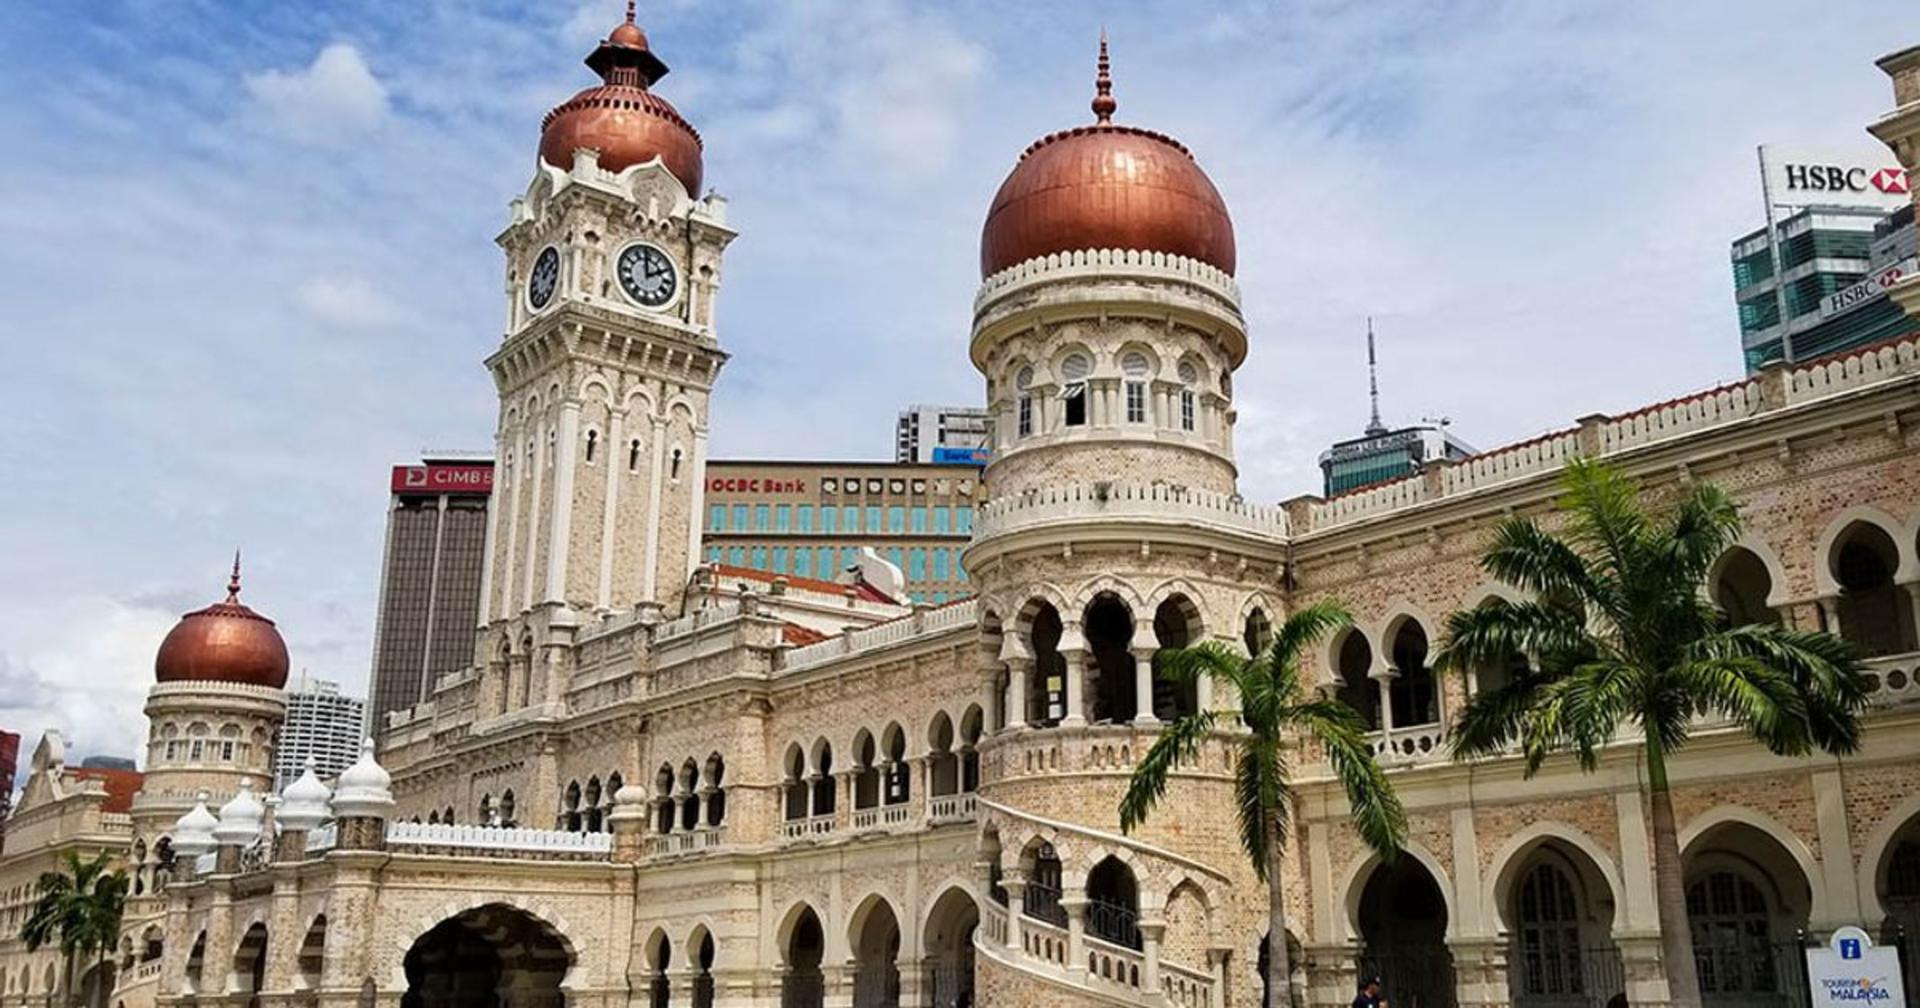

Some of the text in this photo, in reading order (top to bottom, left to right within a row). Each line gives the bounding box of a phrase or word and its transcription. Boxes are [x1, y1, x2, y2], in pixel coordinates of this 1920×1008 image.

[1785, 164, 1867, 192] HSBC
[1831, 279, 1877, 311] HSBC
[434, 470, 481, 484] CIMB
[712, 478, 805, 493] OCBC Bank
[1830, 987, 1890, 1006] MALAYSIA
